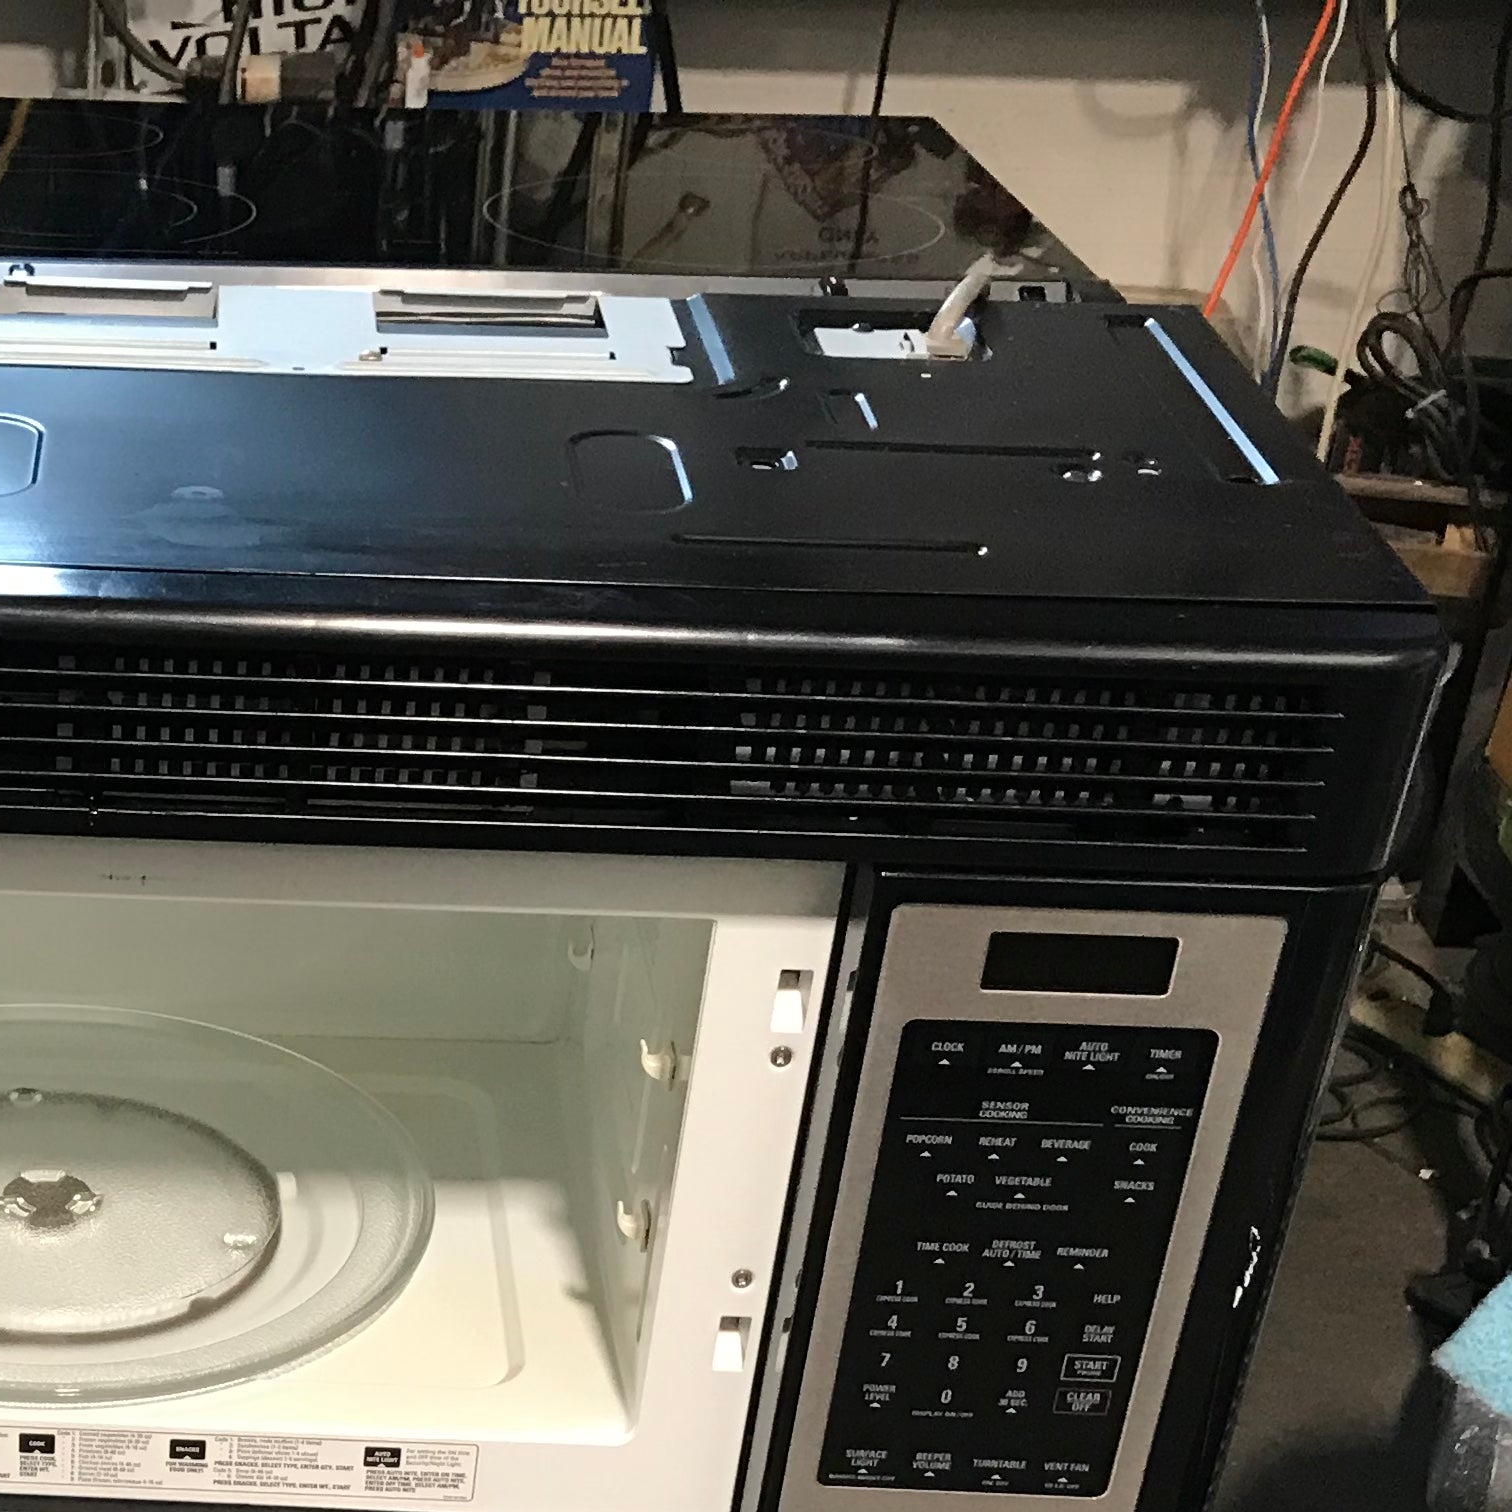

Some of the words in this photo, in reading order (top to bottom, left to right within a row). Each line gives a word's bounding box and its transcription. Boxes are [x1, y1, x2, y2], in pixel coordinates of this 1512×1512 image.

[149, 16, 356, 65] VOLTA
[519, 16, 648, 54] MANUAL
[931, 1042, 964, 1053] CLOCK
[1079, 1041, 1108, 1051] AUTO
[1063, 1051, 1088, 1061] NITE
[1089, 1052, 1120, 1062] LIGHT
[1149, 1049, 1182, 1059] TIMER
[981, 1101, 1029, 1110] SENSOR
[1110, 1105, 1194, 1117] CONVENIENCE
[979, 1110, 1028, 1119] COOKING
[1125, 1116, 1175, 1125] COOKING
[906, 1134, 953, 1145] POPCORN
[978, 1137, 1017, 1147] REHEAT
[1041, 1139, 1091, 1150] BEVERAGE
[1129, 1142, 1158, 1152] COOK
[936, 1173, 975, 1184] POTATO
[995, 1175, 1052, 1187] VEGETABLE
[1114, 1180, 1155, 1191] SNACKS
[917, 1241, 941, 1251] TIME
[942, 1242, 970, 1252] COOK
[992, 1239, 1036, 1250] DEFROST
[1056, 1246, 1109, 1258] REMINDER
[895, 1280, 904, 1294] 1
[963, 1282, 975, 1297] 2
[1032, 1285, 1044, 1299] 3
[1093, 1293, 1121, 1304] HELP
[887, 1314, 898, 1329] 4
[955, 1317, 968, 1331] 5
[1024, 1320, 1037, 1335] 6
[1084, 1324, 1115, 1334] DELAY
[1082, 1333, 1114, 1343] START
[880, 1352, 891, 1367] 7
[947, 1355, 960, 1370] 8
[1074, 1360, 1108, 1370] START
[1016, 1358, 1028, 1373] 9
[863, 1383, 896, 1393] POWER
[1005, 1389, 1026, 1398] ADD
[864, 1392, 890, 1401] LEVEL
[940, 1389, 952, 1404] 0
[1066, 1391, 1101, 1402] CLEAR
[1071, 1401, 1092, 1412] OFF
[845, 1449, 888, 1459] SURFACE
[916, 1452, 952, 1461] BEEPER
[851, 1458, 879, 1468] LIGHT
[912, 1460, 952, 1470] VOLUME
[973, 1458, 1027, 1470] TURNTABLE
[1044, 1462, 1069, 1472] VENT
[1070, 1463, 1090, 1472] FAN
